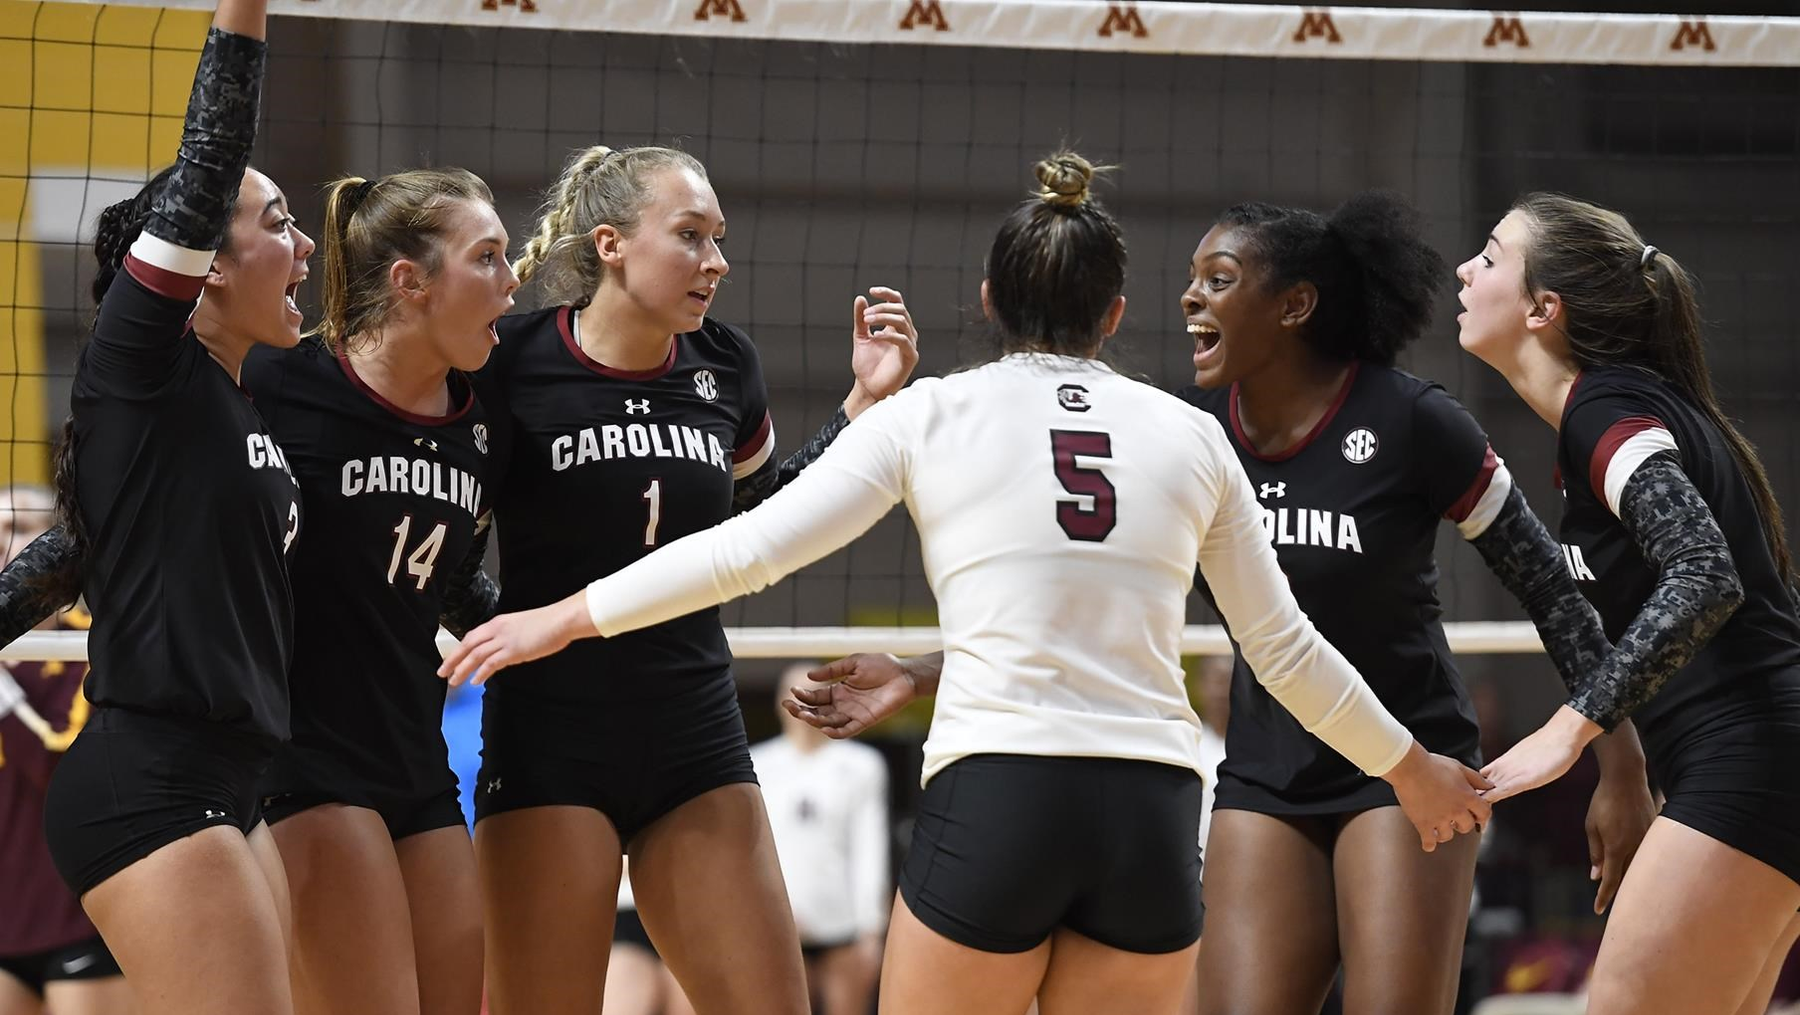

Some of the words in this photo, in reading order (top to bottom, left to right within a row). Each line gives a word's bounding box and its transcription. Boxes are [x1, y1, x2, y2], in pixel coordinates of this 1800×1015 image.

[899, 0, 950, 31] M
[1098, 6, 1149, 37] M
[1293, 11, 1343, 43] M
[1483, 17, 1530, 47] M
[1670, 21, 1716, 50] M
[694, 369, 719, 402] SEC
[551, 423, 727, 472] CAROLINA
[1343, 428, 1377, 463] SEC
[1050, 428, 1117, 542] 5
[643, 479, 661, 545] 1
[387, 514, 447, 590] 14
